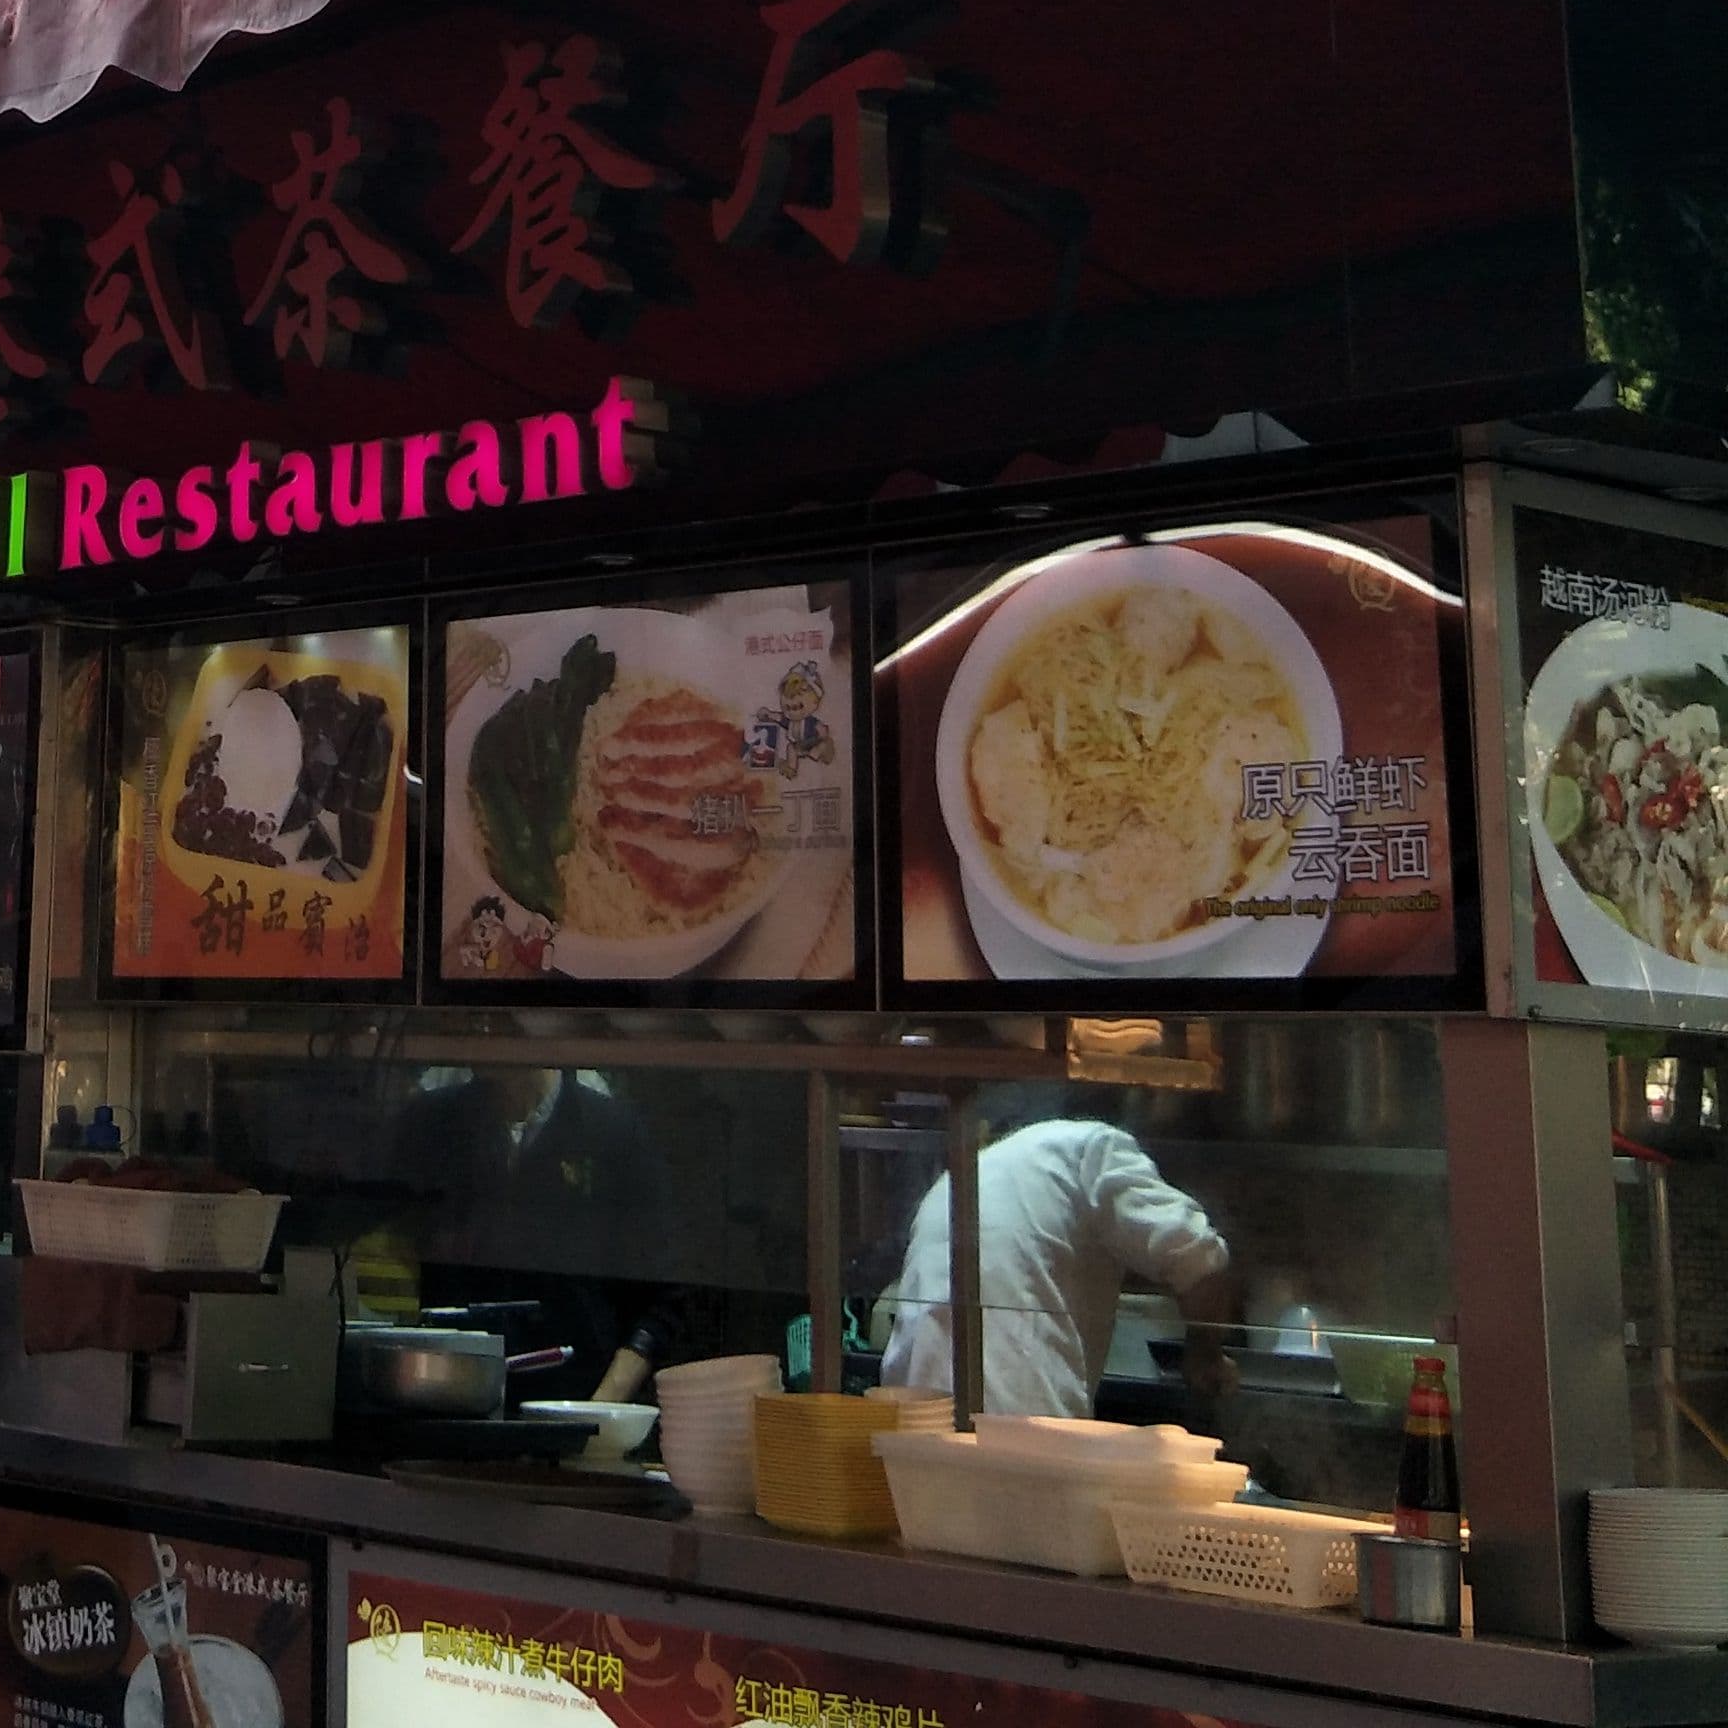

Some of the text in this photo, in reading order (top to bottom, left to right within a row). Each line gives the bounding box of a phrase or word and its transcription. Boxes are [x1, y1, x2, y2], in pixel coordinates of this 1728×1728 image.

[59, 375, 638, 571] Restaurant
[1539, 563, 1671, 631] 越南汤河粉
[1240, 754, 1427, 820] 原只鲜虾
[1288, 822, 1431, 884] 云吞面
[1385, 891, 1441, 913] noodle
[473, 1674, 497, 1695] spicy
[500, 1682, 527, 1699] sauce
[529, 1689, 567, 1710] cowboy
